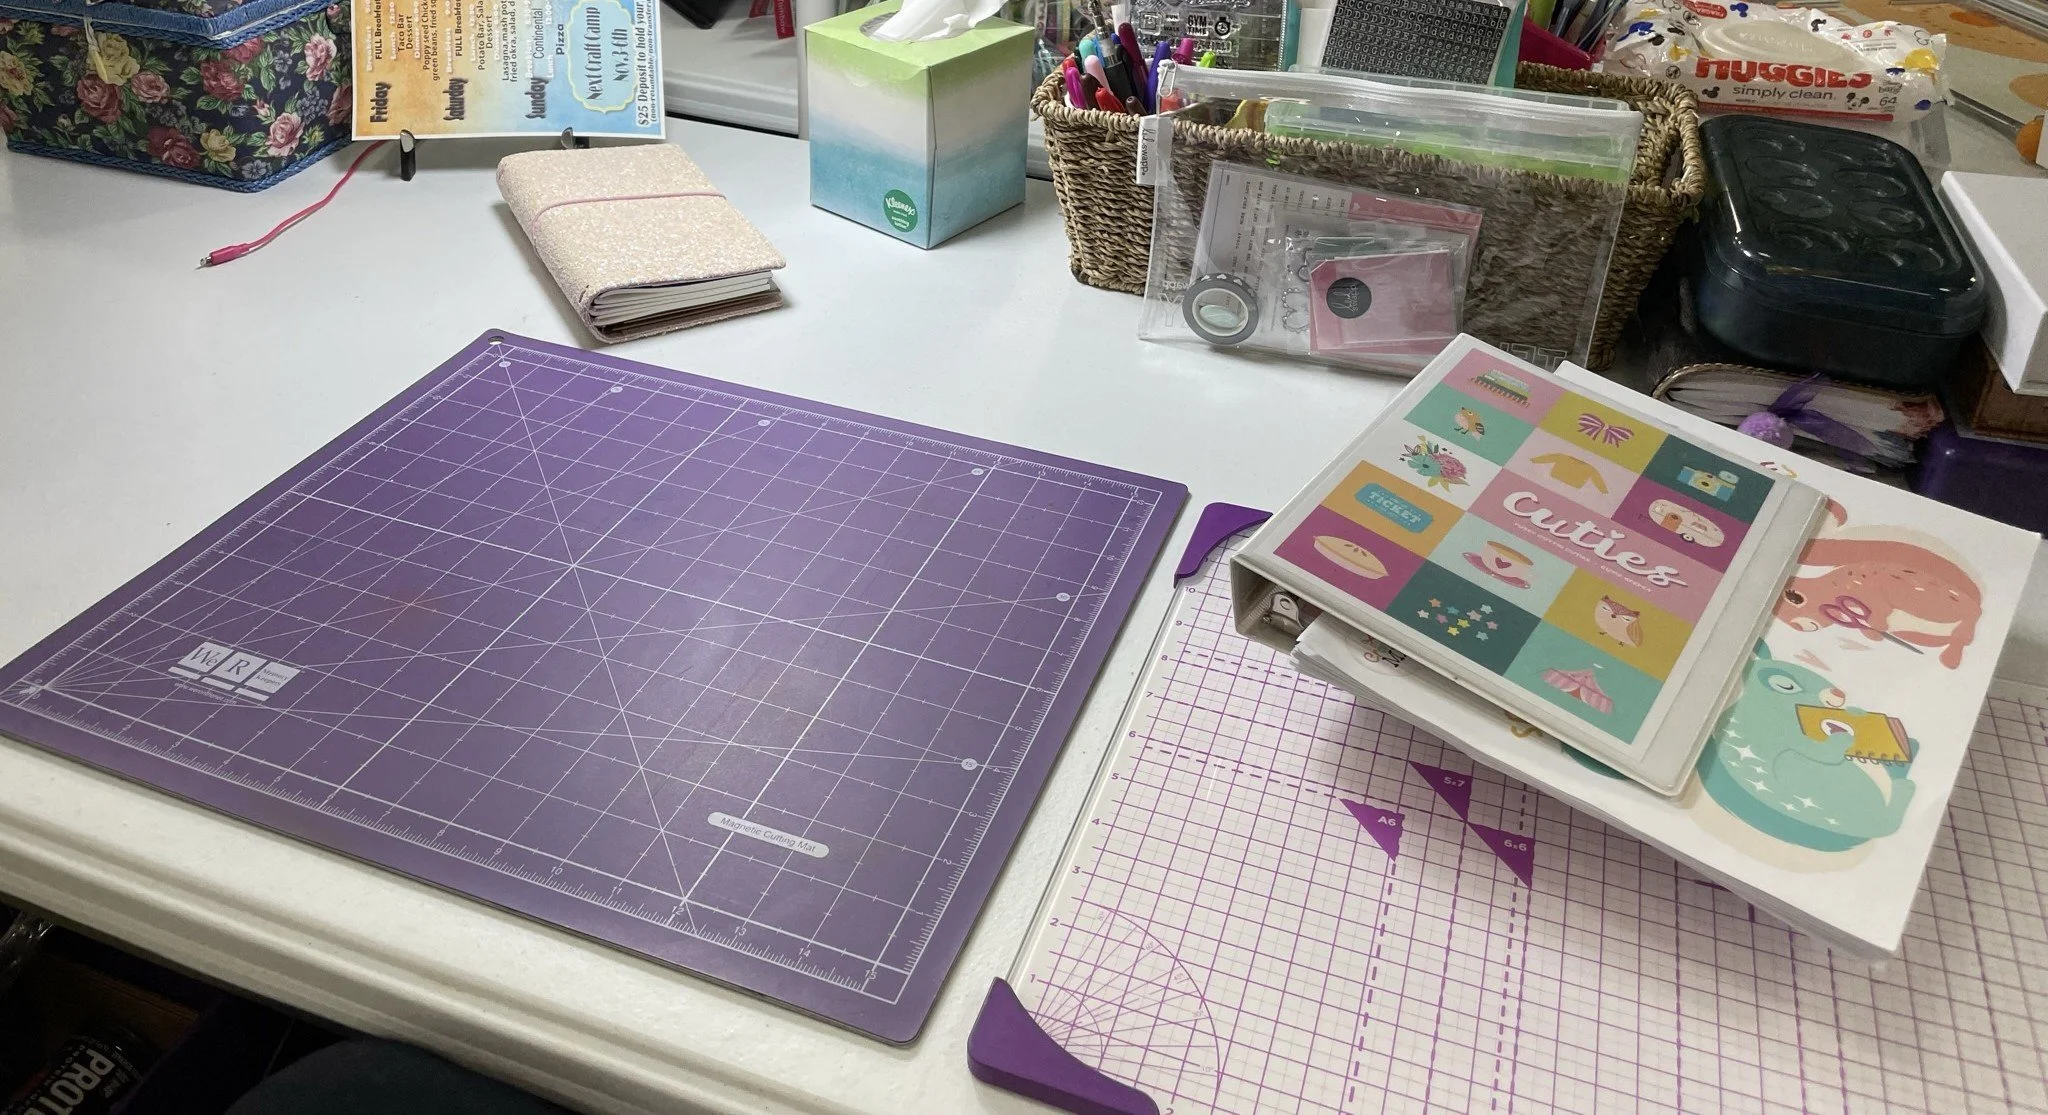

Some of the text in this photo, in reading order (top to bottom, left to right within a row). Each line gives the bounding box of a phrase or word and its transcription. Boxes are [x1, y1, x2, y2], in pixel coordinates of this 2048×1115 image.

[429, 10, 437, 28] fried
[507, 8, 516, 35] salad,
[1187, 14, 1208, 27] GYM
[485, 15, 493, 49] Dessert
[532, 8, 545, 59] Continental
[556, 24, 565, 55] Pizza
[635, 28, 645, 49] hold
[1188, 27, 1208, 35] TIME
[508, 37, 517, 59] okra,
[584, 7, 603, 100] Next Craft Camp
[637, 52, 646, 61] to
[431, 58, 440, 81] green
[509, 61, 518, 82] fried
[1695, 55, 1873, 89] HUGGIES
[637, 65, 648, 102] Deposit
[1732, 84, 1786, 101] simply
[370, 83, 390, 122] Friday
[442, 78, 468, 121] Saturday
[524, 77, 548, 119] Sunday
[1879, 96, 1898, 106] 64
[638, 105, 649, 125] $25
[885, 196, 916, 216] Kleenex
[1502, 491, 1689, 588] Cuties
[190, 646, 251, 676] We R
[1128, 730, 1137, 738] 6
[1111, 772, 1120, 780] 5
[1443, 776, 1465, 788] 5x7
[1377, 815, 1397, 826] A6
[720, 817, 817, 853] Magnetic Cutting Mat
[1503, 839, 1527, 852] 6x6
[551, 866, 564, 876] 10
[1072, 865, 1080, 874] 3
[612, 885, 623, 896] 11
[671, 905, 685, 915] 12
[735, 926, 747, 936] 13
[1050, 917, 1059, 927] 2
[798, 948, 811, 958] 14
[864, 969, 877, 980] 15
[23, 1048, 115, 1115] PROT
